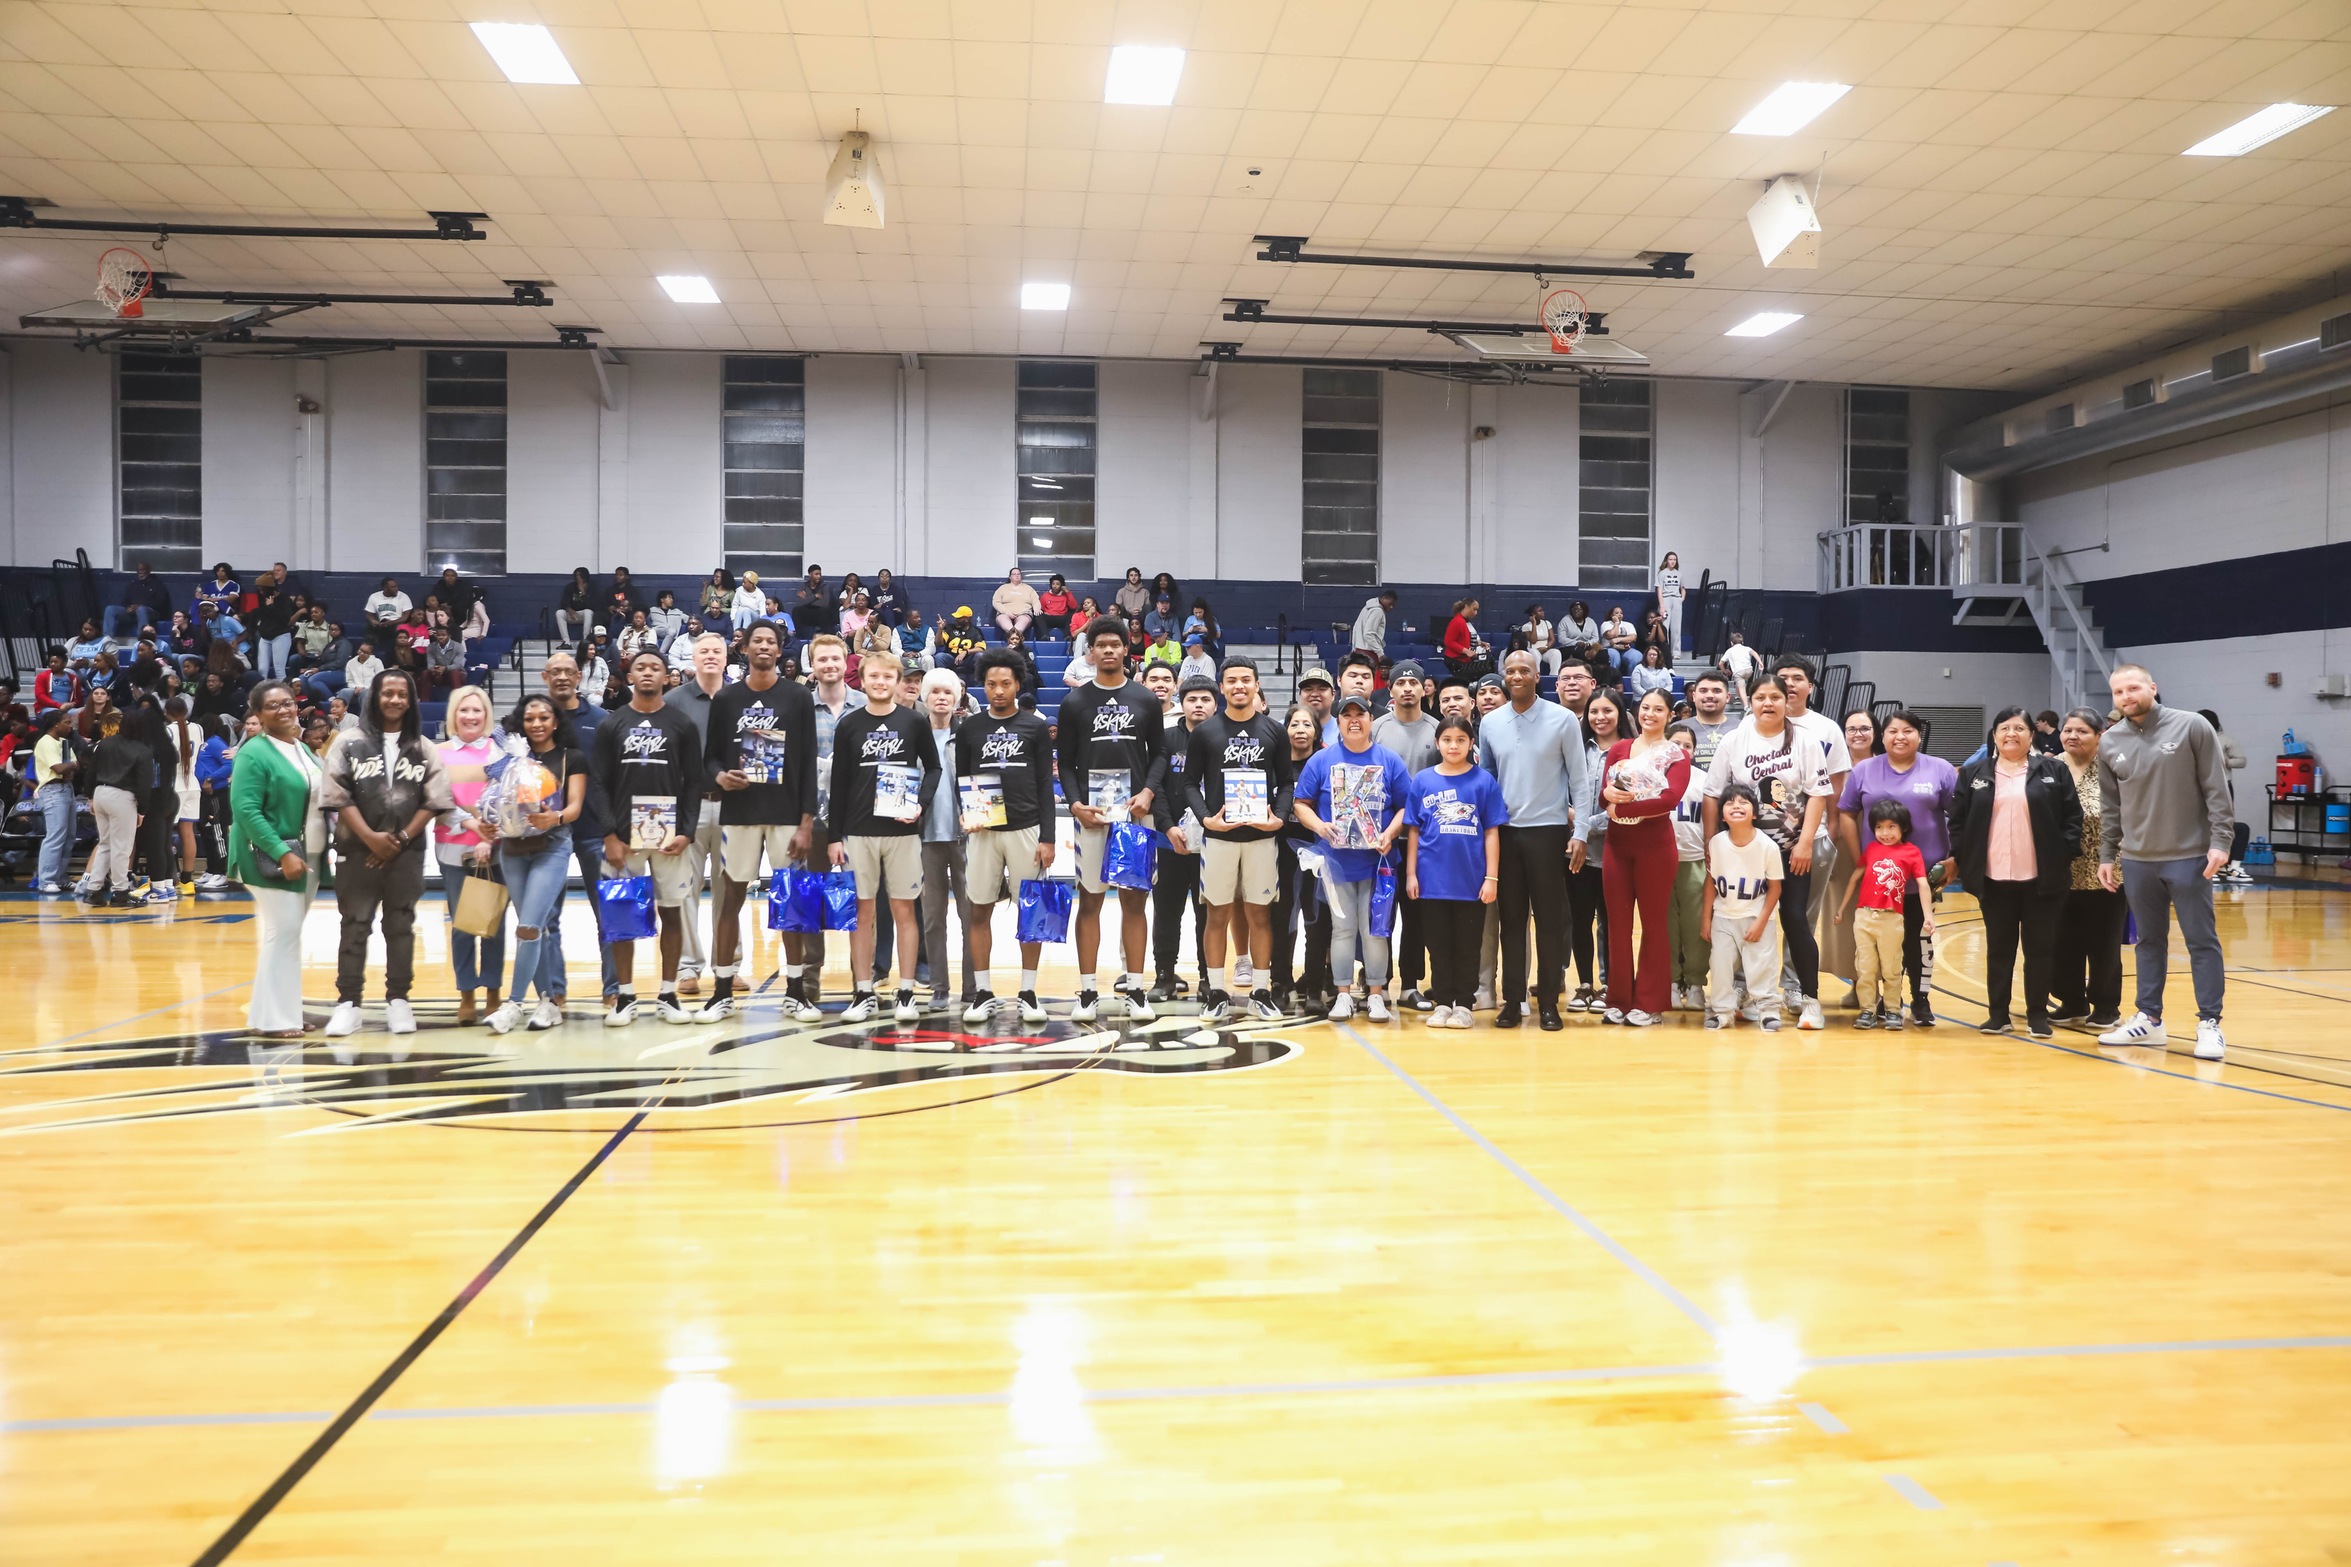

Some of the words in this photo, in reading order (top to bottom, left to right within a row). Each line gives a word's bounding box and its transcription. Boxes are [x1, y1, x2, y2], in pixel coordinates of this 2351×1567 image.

[743, 708, 774, 716] CO-LIN
[1097, 705, 1128, 714] CO-LIN
[630, 727, 662, 736] CO-LIN
[867, 731, 898, 740] CO-LIN
[987, 733, 1018, 741] CO-LIN
[1228, 737, 1259, 746] CO-LIN
[1745, 746, 1792, 768] Choctaw
[395, 757, 425, 782] PAR
[1751, 757, 1793, 780] Central
[1422, 788, 1457, 809] CO-LIN
